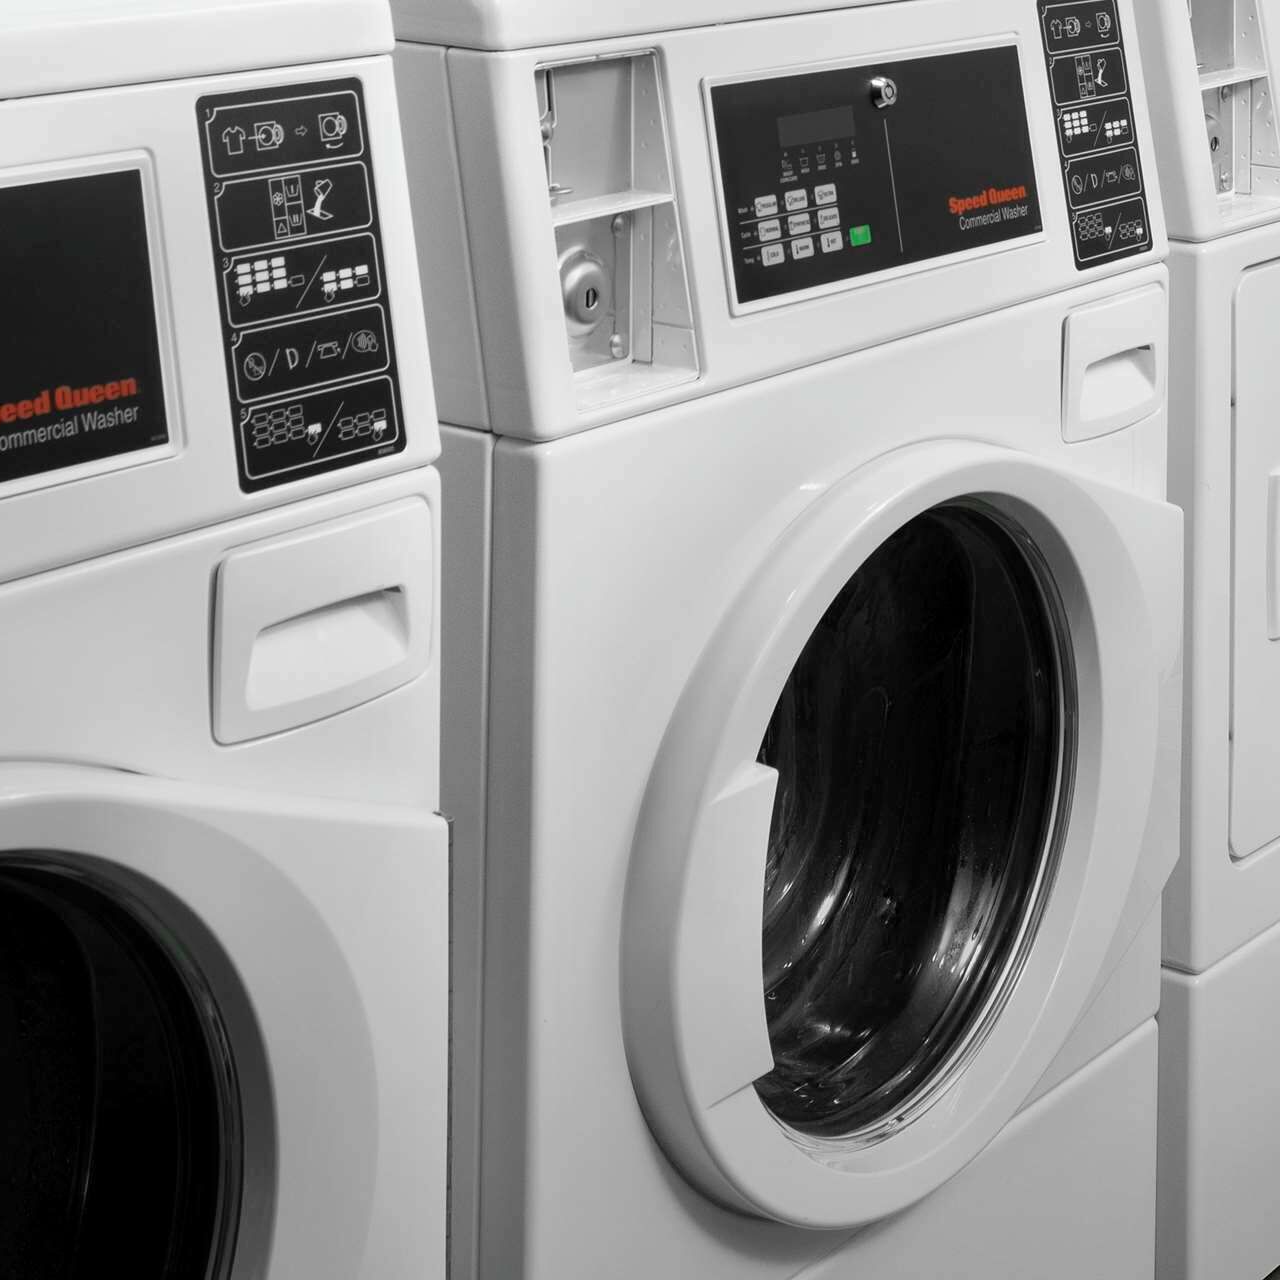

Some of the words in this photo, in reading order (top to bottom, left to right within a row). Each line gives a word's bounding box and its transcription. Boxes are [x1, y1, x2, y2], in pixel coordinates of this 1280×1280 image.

[205, 107, 211, 118] 1
[213, 182, 221, 193] 2
[949, 190, 988, 216] Speed
[988, 185, 1026, 204] Queen
[960, 209, 1001, 230] Commercial
[1002, 204, 1028, 220] Washer
[222, 257, 230, 268] 3
[230, 332, 238, 343] 4
[54, 377, 137, 410] Queen
[81, 406, 140, 433] Washer
[239, 408, 247, 420] 5
